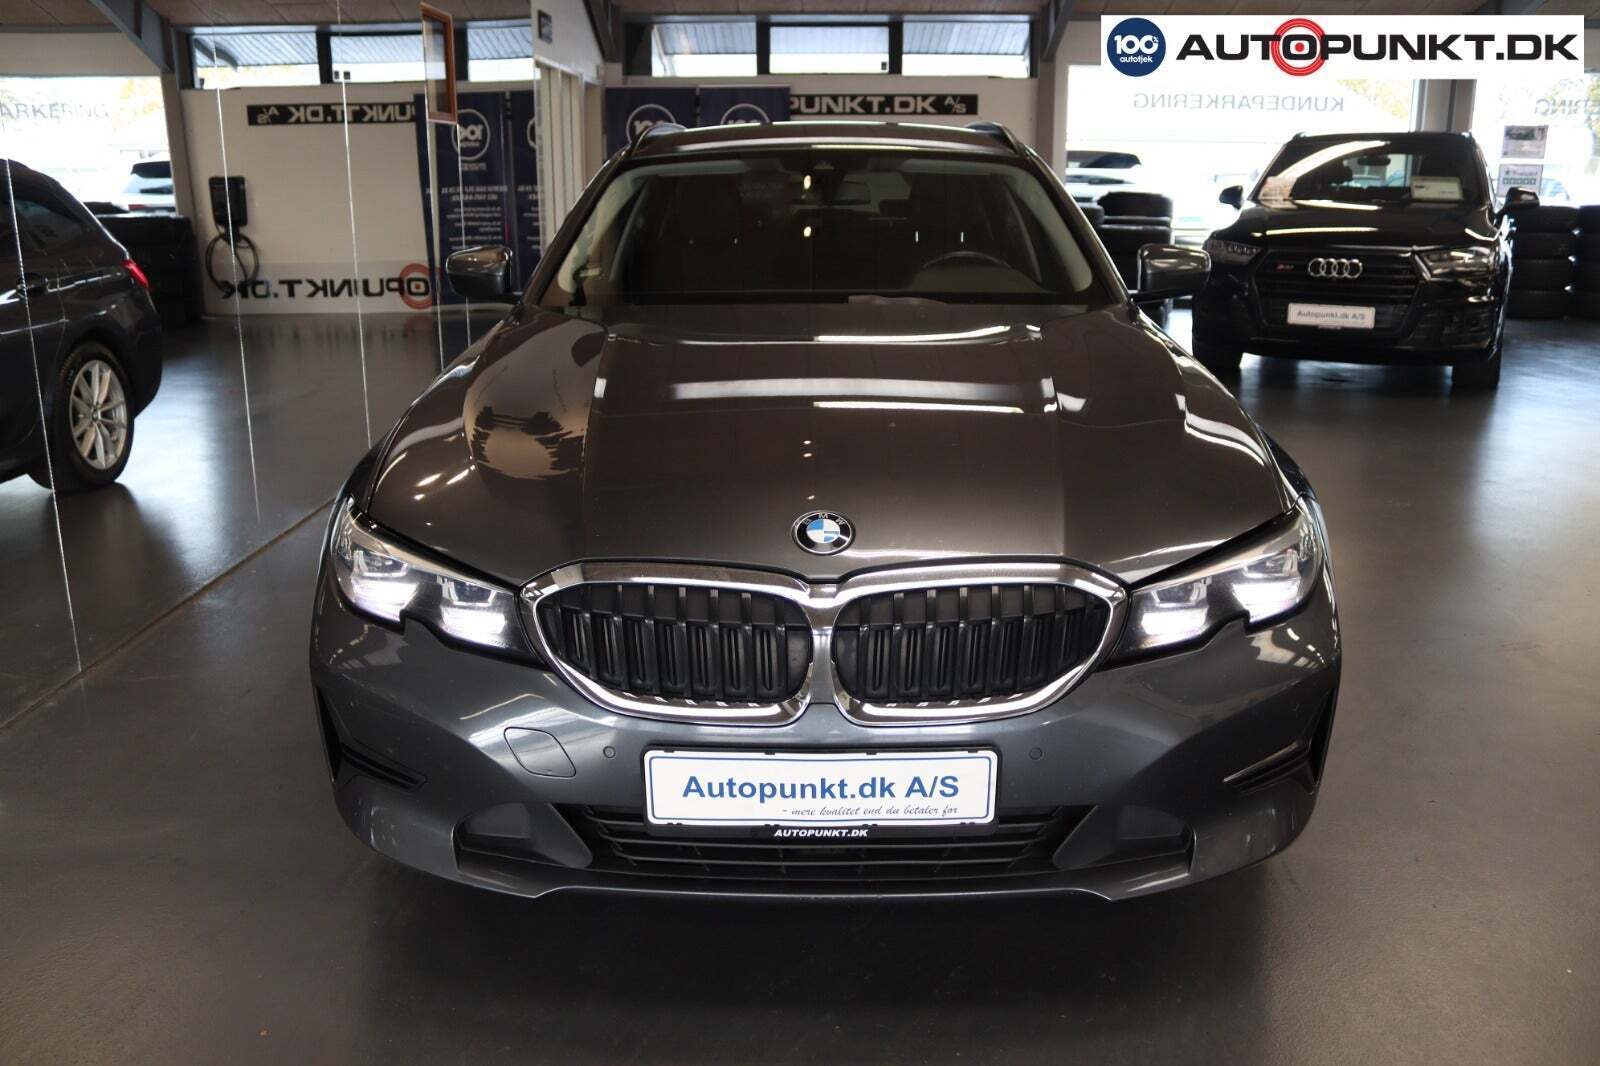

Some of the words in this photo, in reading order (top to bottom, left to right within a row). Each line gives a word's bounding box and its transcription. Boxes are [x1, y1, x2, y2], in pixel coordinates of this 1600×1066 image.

[944, 96, 967, 114] A/S
[682, 775, 896, 803] Autopunkt.dk
[905, 775, 959, 798] A/S
[863, 806, 882, 816] end
[885, 807, 900, 815] du
[903, 805, 939, 816] betaler
[774, 829, 868, 837] AUTOPUNKT.DK
